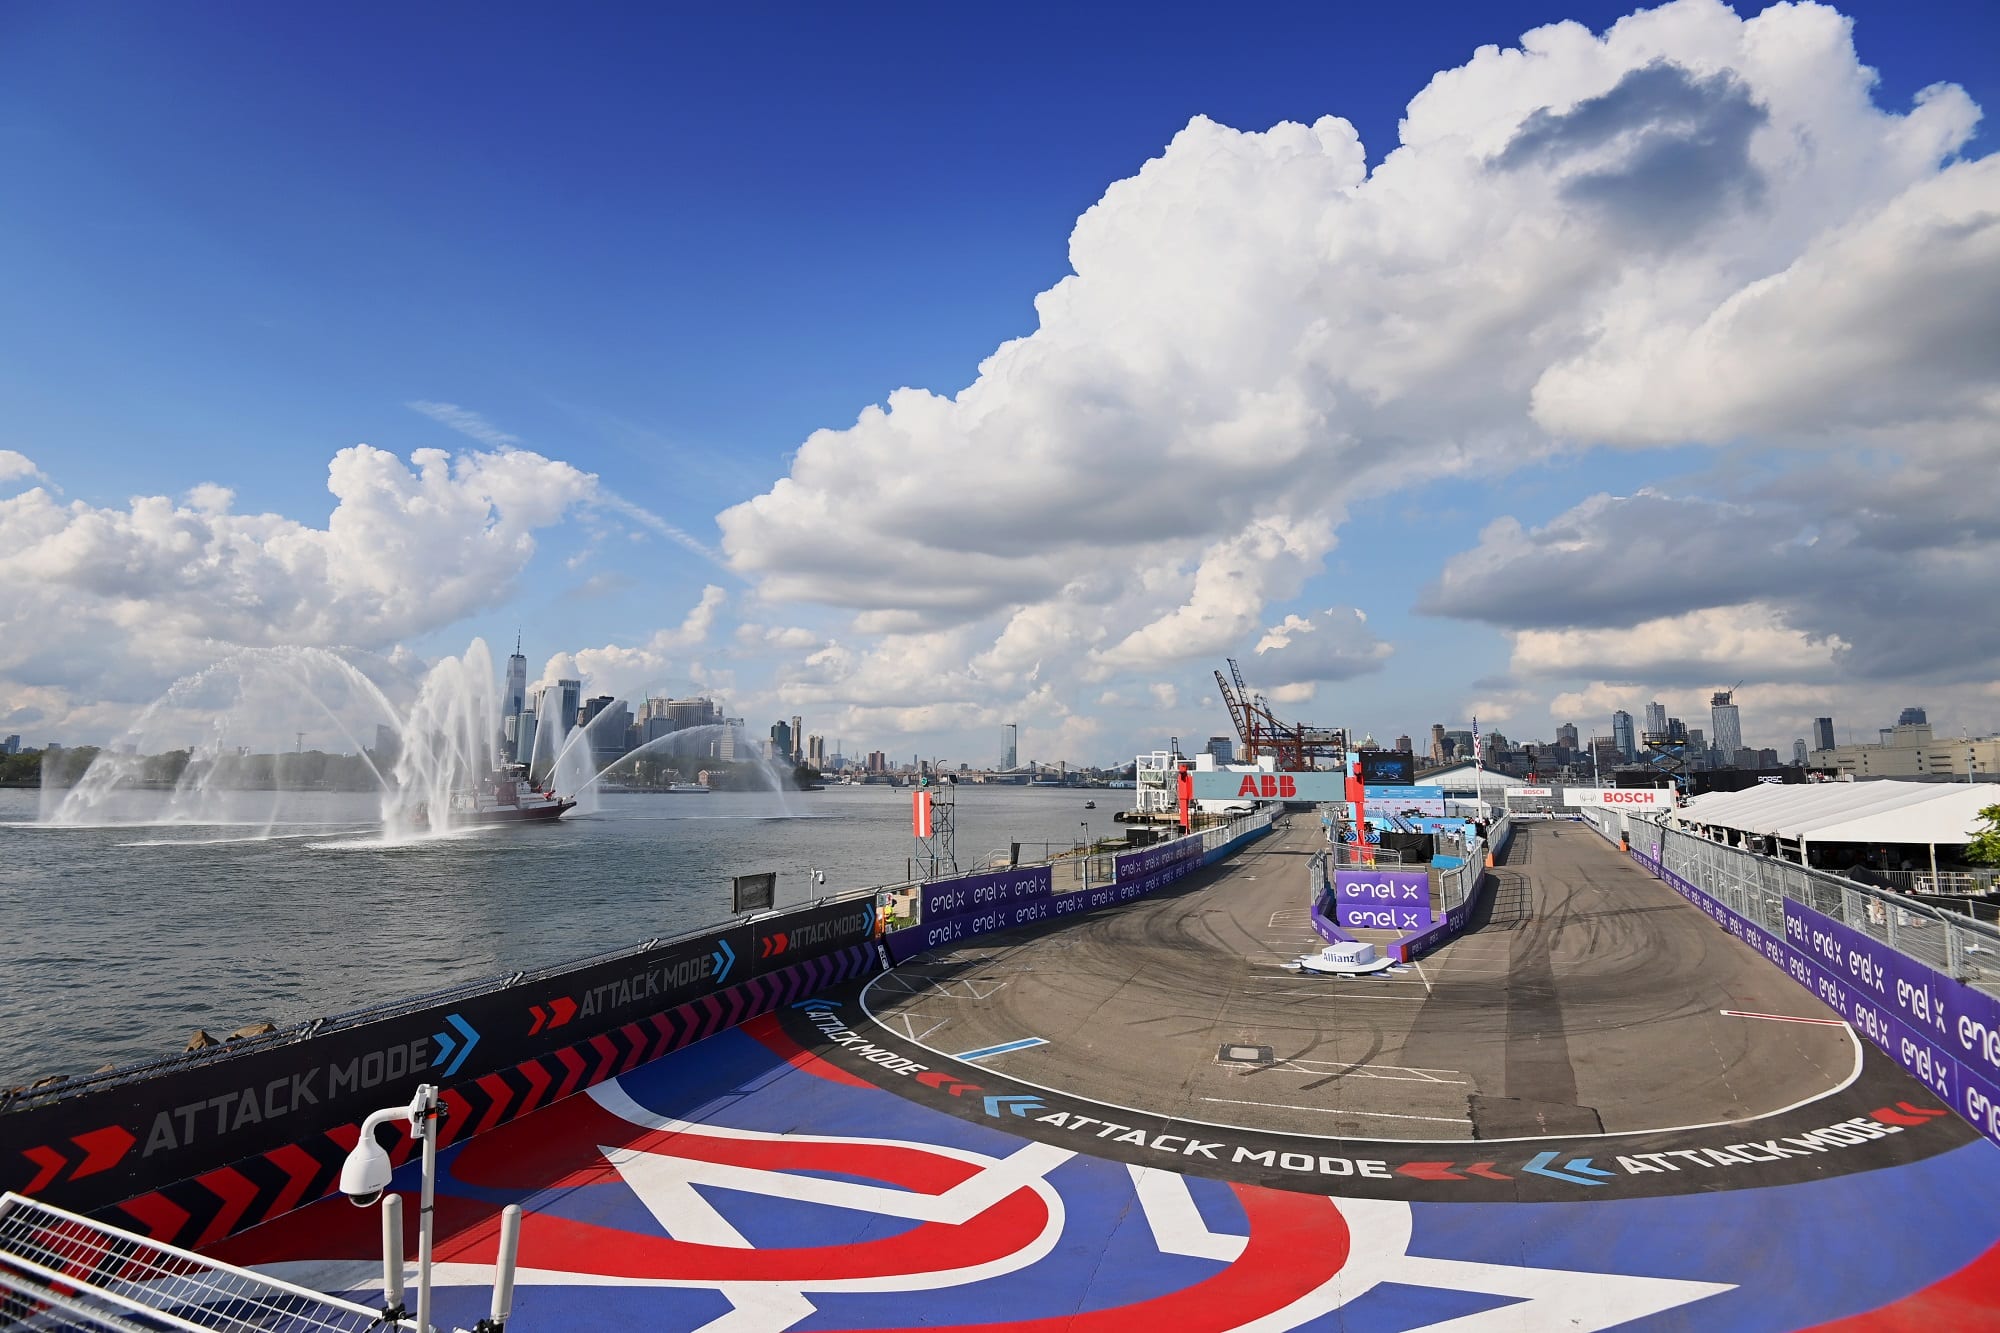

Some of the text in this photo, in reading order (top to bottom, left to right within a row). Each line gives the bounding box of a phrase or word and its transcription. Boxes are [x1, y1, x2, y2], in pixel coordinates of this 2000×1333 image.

[1237, 774, 1297, 798] ABB
[1603, 792, 1655, 803] BOSCH
[1121, 860, 1141, 876] enel x
[973, 881, 1007, 904] enel x
[1015, 875, 1046, 896] enel x
[1091, 889, 1114, 906] enel x
[1121, 884, 1141, 900] enel x
[1346, 880, 1418, 900] enel x
[931, 888, 965, 913] enel x
[1016, 902, 1047, 923] enel x
[1056, 895, 1083, 914] enel x
[972, 911, 1005, 933] enel x
[1349, 908, 1418, 928] enel x
[1787, 915, 1809, 945] enel x
[788, 914, 862, 951] ATTACK MODE
[928, 920, 962, 946] enel x
[1323, 951, 1355, 964] Allianz
[1813, 930, 1843, 967] enel x
[1789, 956, 1812, 988] enel x
[1849, 950, 1885, 994] enel x
[579, 953, 711, 1020] ATTACK MODE
[1819, 977, 1847, 1015] enel x
[1897, 978, 1946, 1034] enel x
[1855, 1003, 1889, 1049] enel x
[806, 1011, 930, 1076] ATTACK MODE
[1901, 1037, 1948, 1097] enel x
[141, 1037, 429, 1159] ATTACK MODE
[1034, 1111, 1394, 1180] ATTACK MODE
[1615, 1116, 1905, 1175] ATTACK MODE
